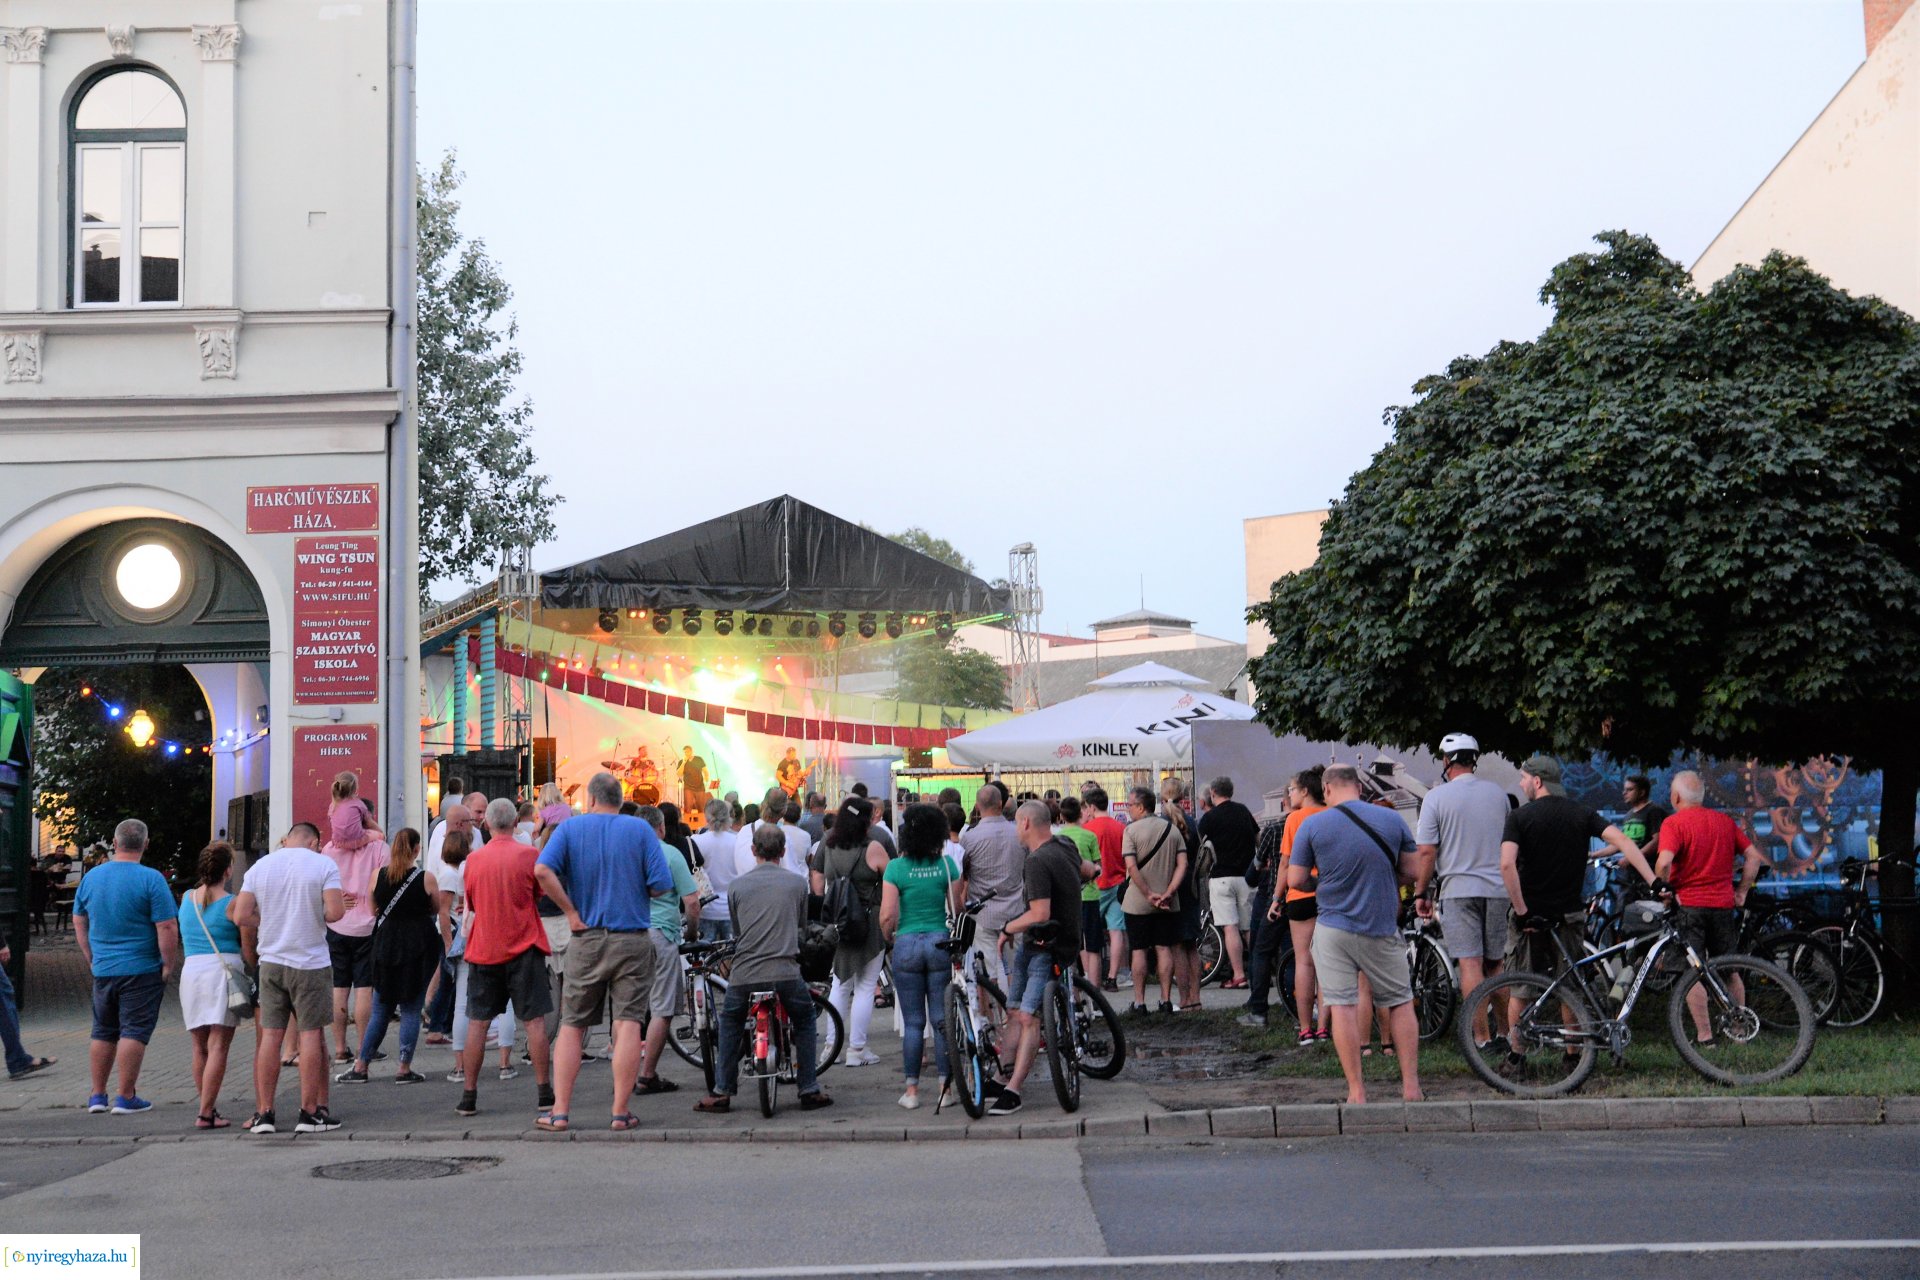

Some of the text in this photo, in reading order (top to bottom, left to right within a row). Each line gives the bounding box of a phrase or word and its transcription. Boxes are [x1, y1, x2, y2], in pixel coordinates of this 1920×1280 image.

[315, 541, 359, 551] Leung Ting
[297, 552, 375, 565] WING TSUN
[320, 566, 353, 575] kung-fu
[302, 592, 371, 601] WWW.SIFU.HU
[301, 617, 371, 628] Simonyi Óbester
[311, 631, 361, 641] MAGYAR
[296, 643, 376, 655] SZABLYAVÍVÓ
[314, 659, 358, 669] ISKOLA
[304, 732, 368, 742] PROGRAMOK
[320, 746, 352, 756] HÍREK
[1082, 743, 1139, 757] KINLEY
